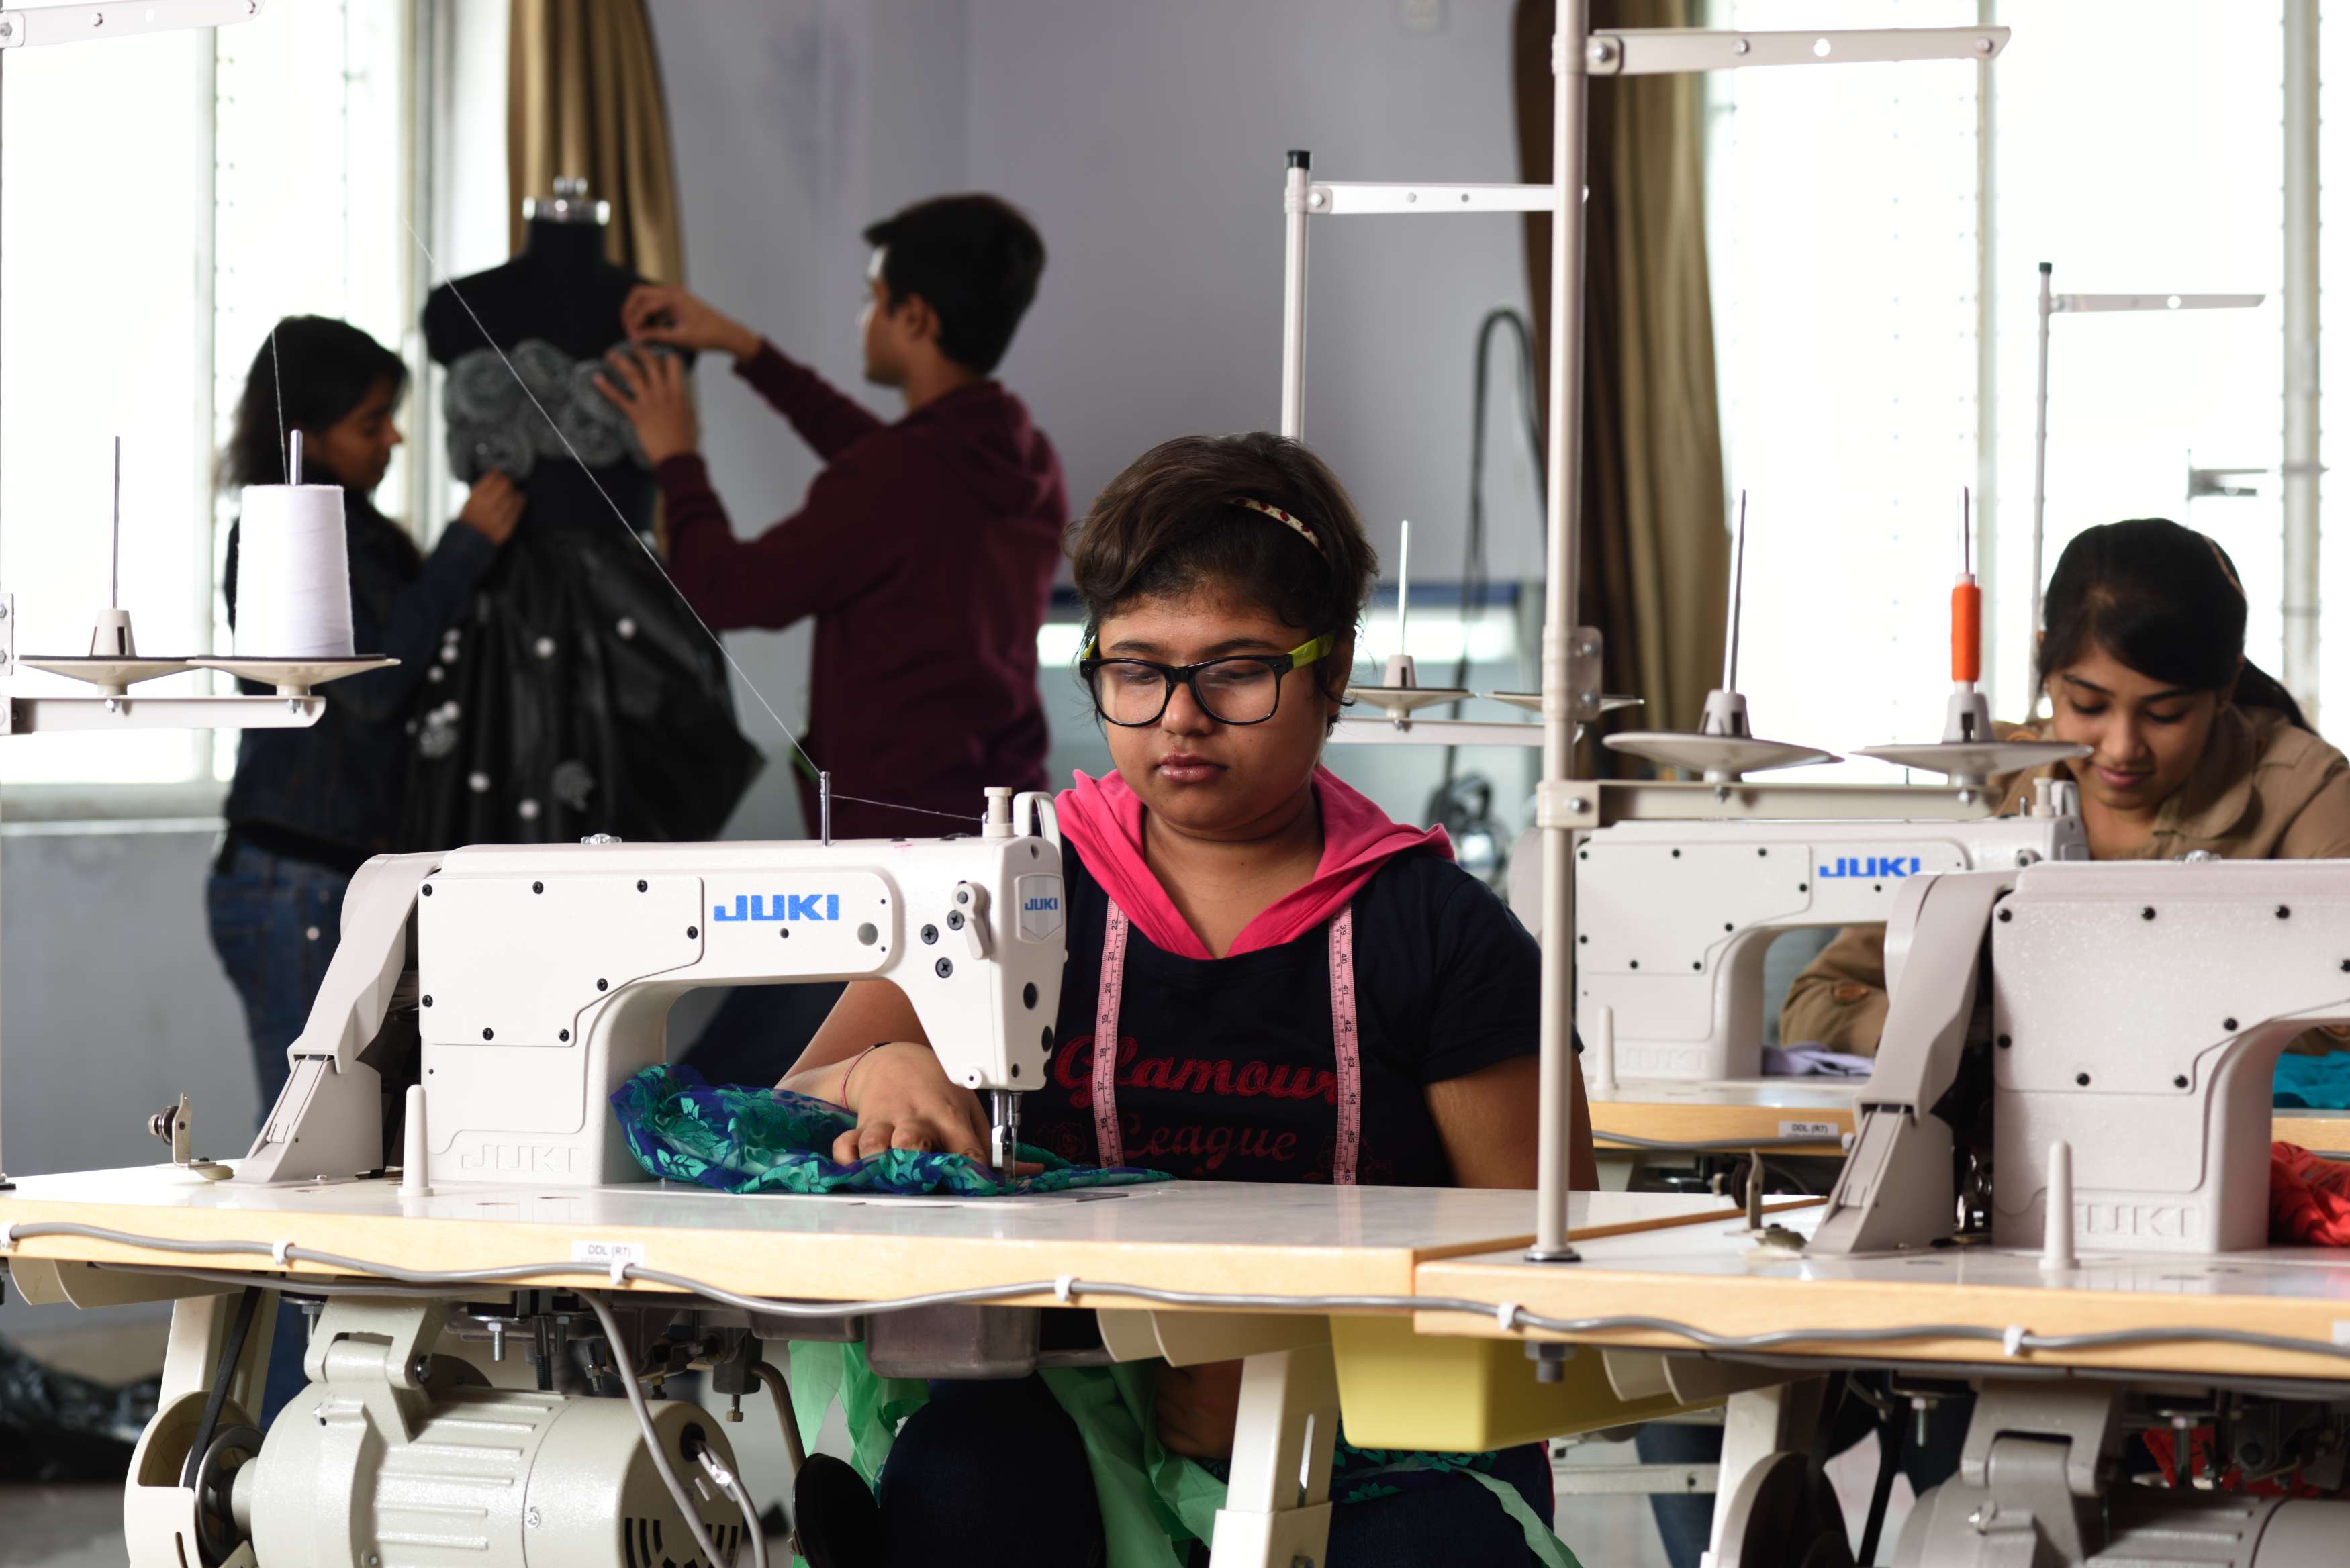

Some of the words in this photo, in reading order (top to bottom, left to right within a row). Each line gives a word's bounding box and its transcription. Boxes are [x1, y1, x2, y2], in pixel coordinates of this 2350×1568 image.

[1819, 857, 1920, 877] JUKI
[714, 894, 839, 922] JUKI
[1024, 897, 1058, 911] JUKI
[1340, 924, 1347, 936] 39
[1107, 951, 1115, 961] 21
[1341, 953, 1348, 965] 40
[1104, 982, 1112, 994] 20
[1343, 985, 1349, 995] 41
[1102, 1014, 1109, 1025] 19
[1345, 1020, 1352, 1032] 42
[1100, 1047, 1107, 1058] 18
[1348, 1055, 1355, 1068] 43
[1098, 1081, 1104, 1091] 17
[1350, 1092, 1356, 1105] 44
[1100, 1117, 1107, 1128] 16
[1121, 1112, 1297, 1169] League
[1348, 1130, 1355, 1144] 45
[461, 1144, 581, 1173] JUKI
[1345, 1169, 1352, 1181] 46
[588, 1244, 608, 1255] DDL
